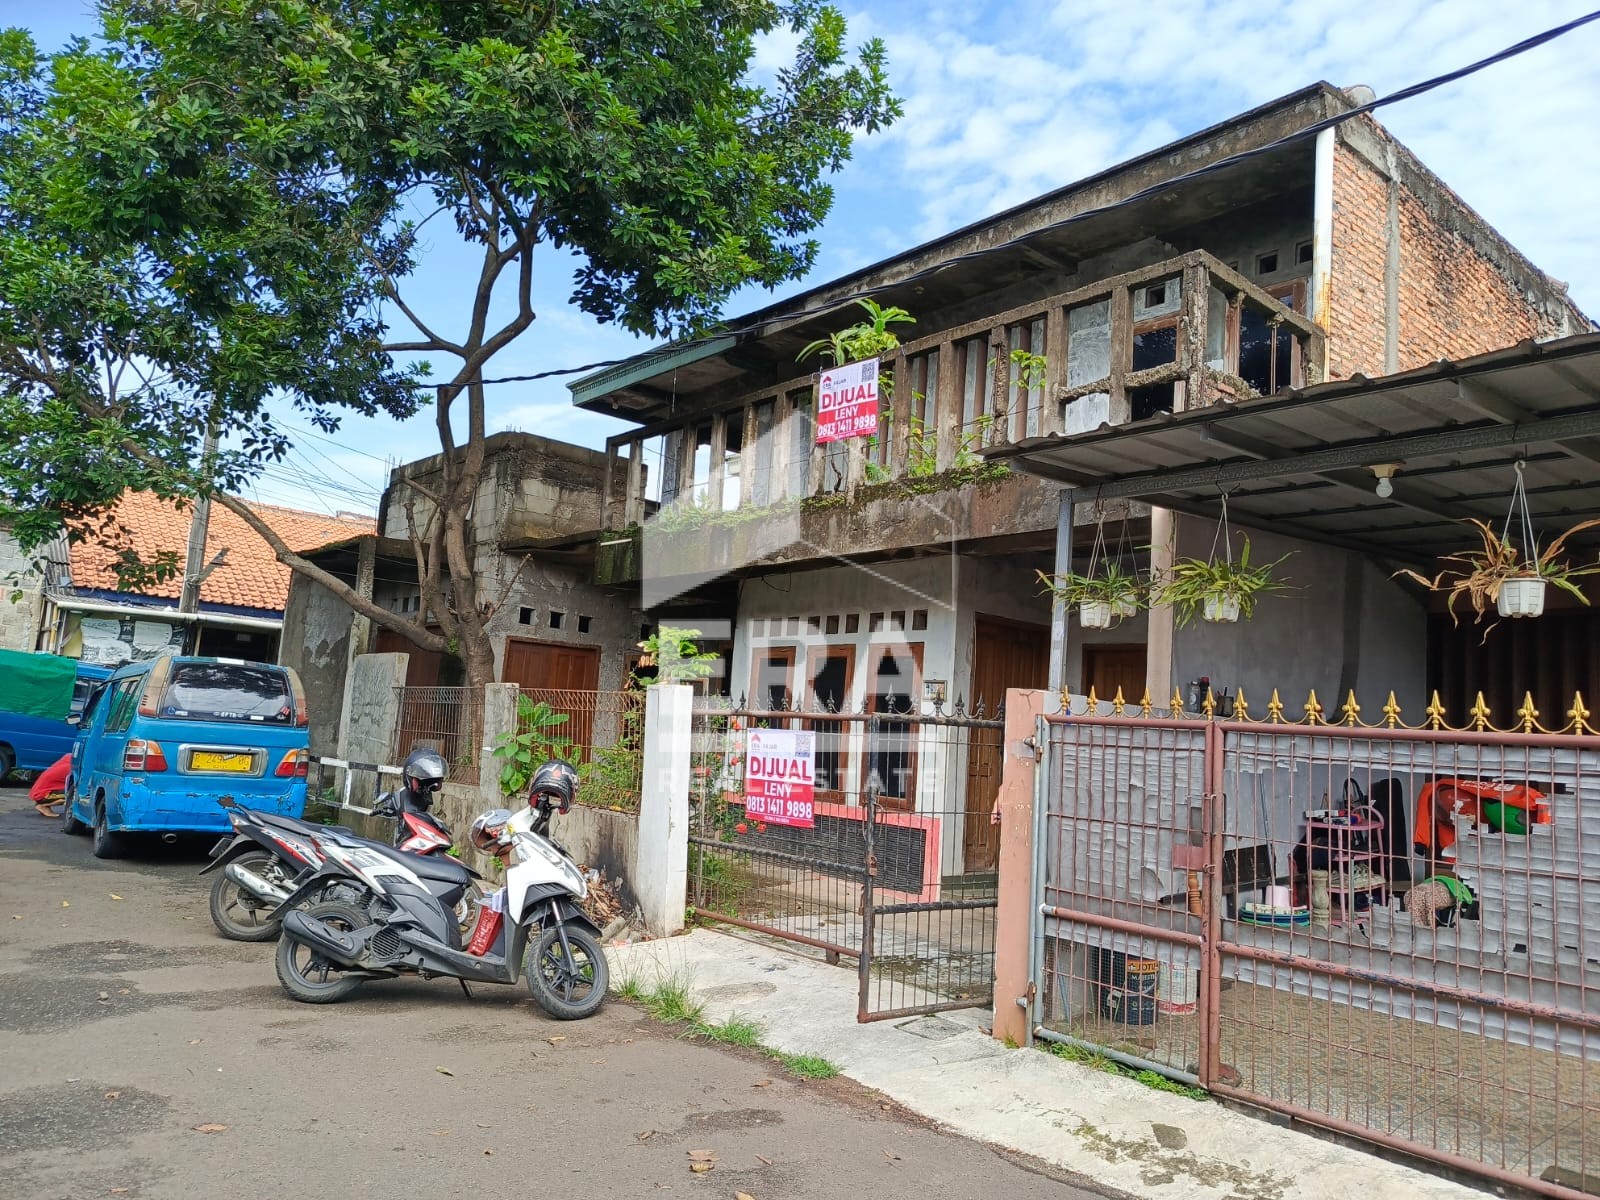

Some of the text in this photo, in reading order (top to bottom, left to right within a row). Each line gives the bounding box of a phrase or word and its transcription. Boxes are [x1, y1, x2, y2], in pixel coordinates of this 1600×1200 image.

[822, 383, 876, 410] DIJUAL
[835, 406, 859, 420] LENY
[818, 423, 836, 436] 0813
[837, 418, 852, 434] 1411
[854, 414, 876, 429] 9898
[750, 756, 812, 781] DIJUAL
[764, 781, 793, 799] LENY
[746, 796, 812, 819] 0813 1411 9898
